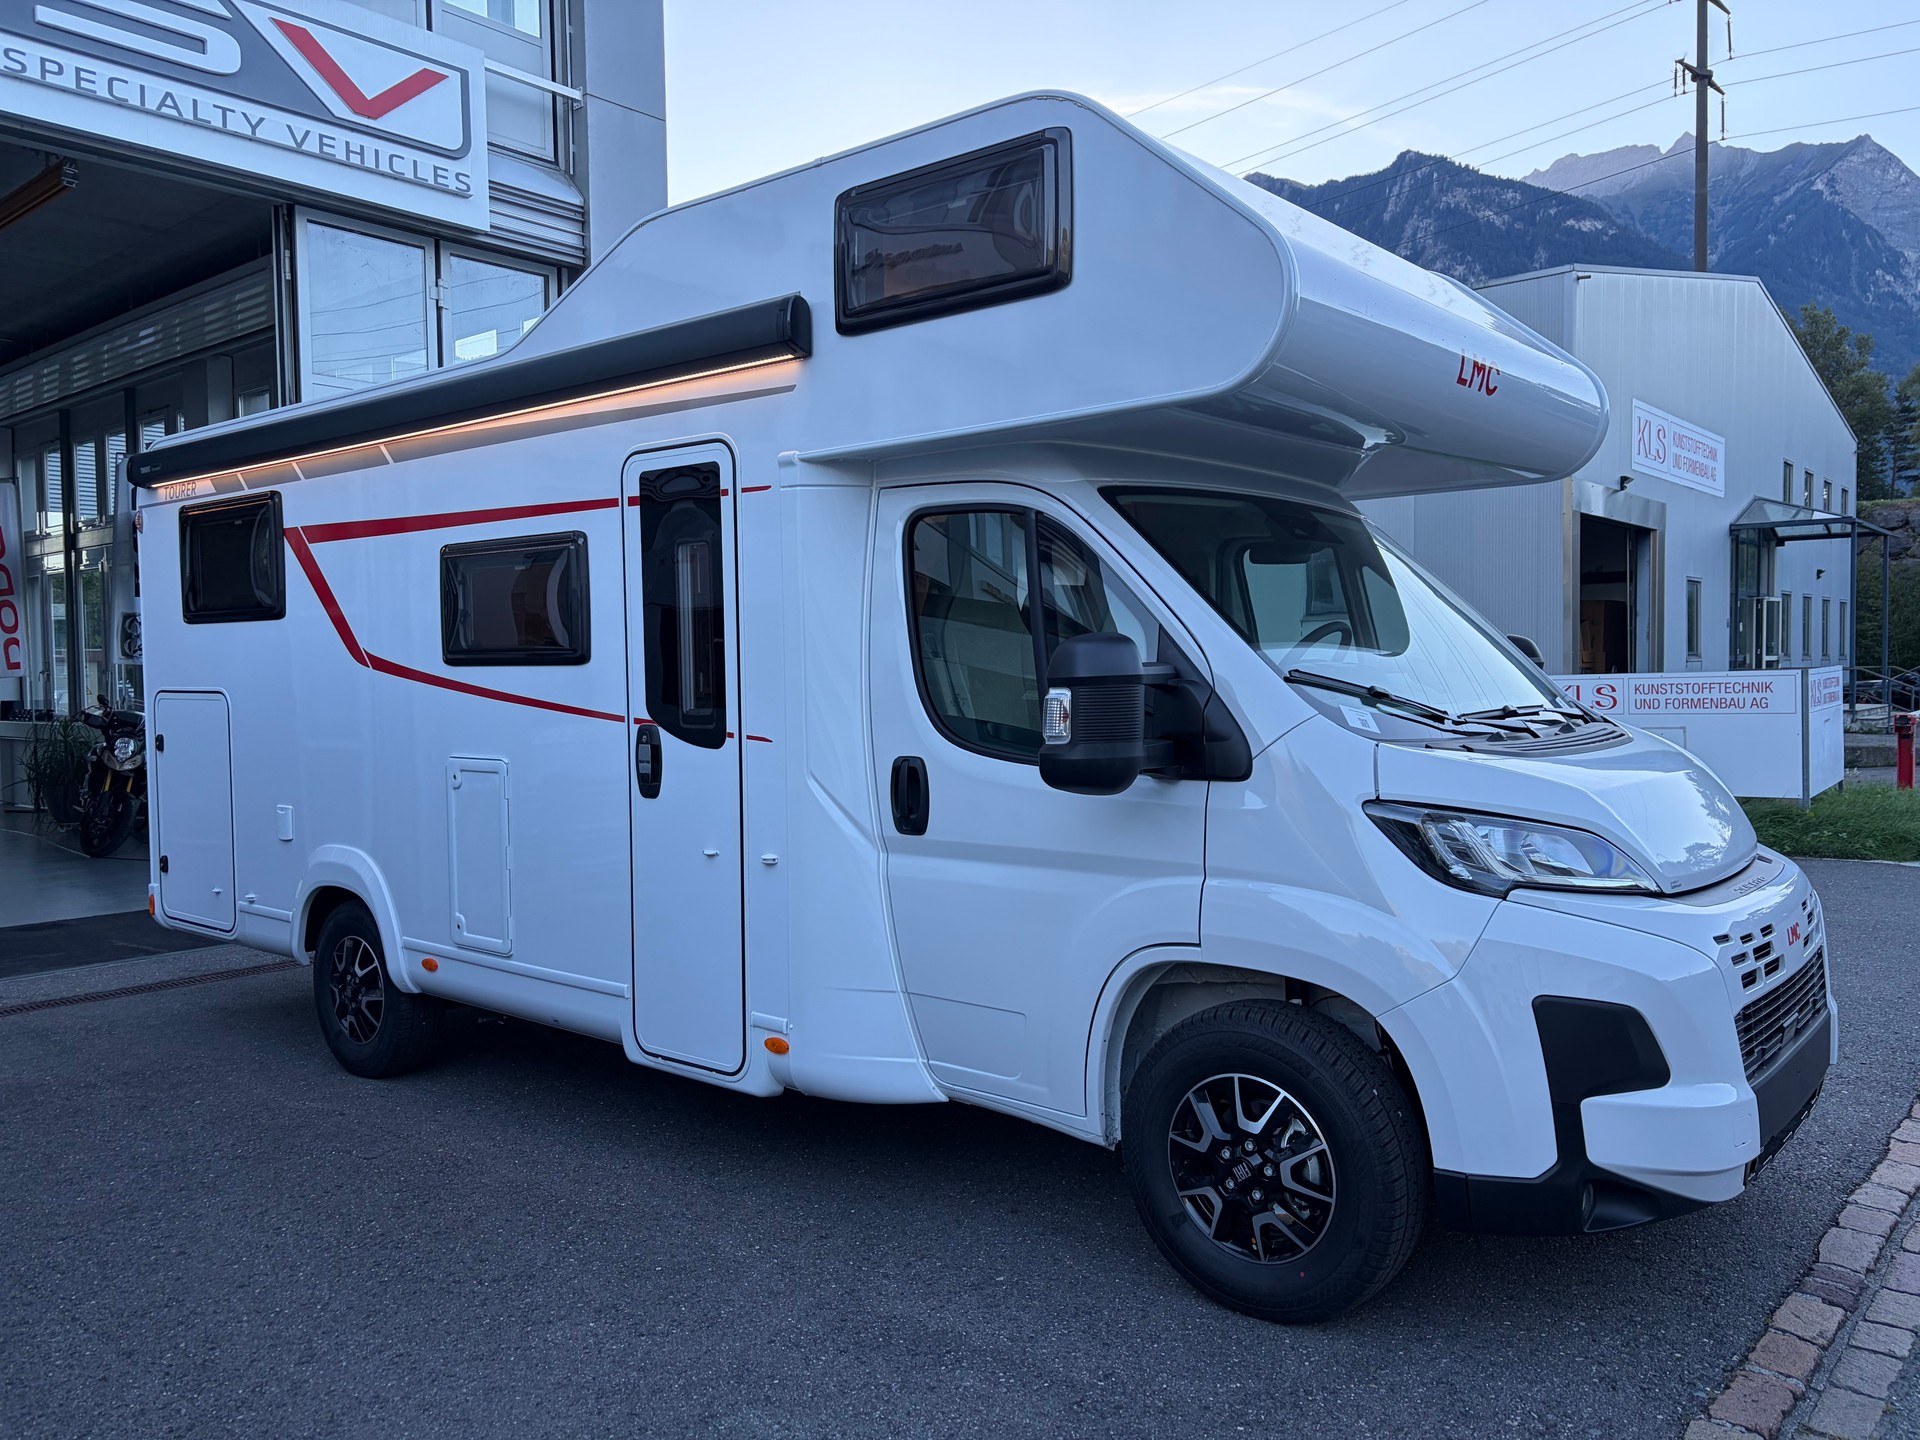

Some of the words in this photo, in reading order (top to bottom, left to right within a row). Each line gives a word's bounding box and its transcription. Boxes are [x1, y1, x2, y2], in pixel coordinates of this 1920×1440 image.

[3, 47, 267, 137] SPECIALTY
[286, 124, 472, 193] VEHICLES
[1456, 350, 1501, 396] LMC
[1637, 415, 1666, 464] KLS
[1673, 452, 1682, 470] UND
[164, 482, 197, 500] TOURER
[1634, 681, 1774, 695] KUNSTSTOFFTECHNIK
[1634, 698, 1661, 710] UND
[1665, 697, 1746, 709] FORMENBAU
[1750, 697, 1769, 709] AG
[1786, 921, 1801, 946] LMC
[1232, 1162, 1251, 1182] FIAT
